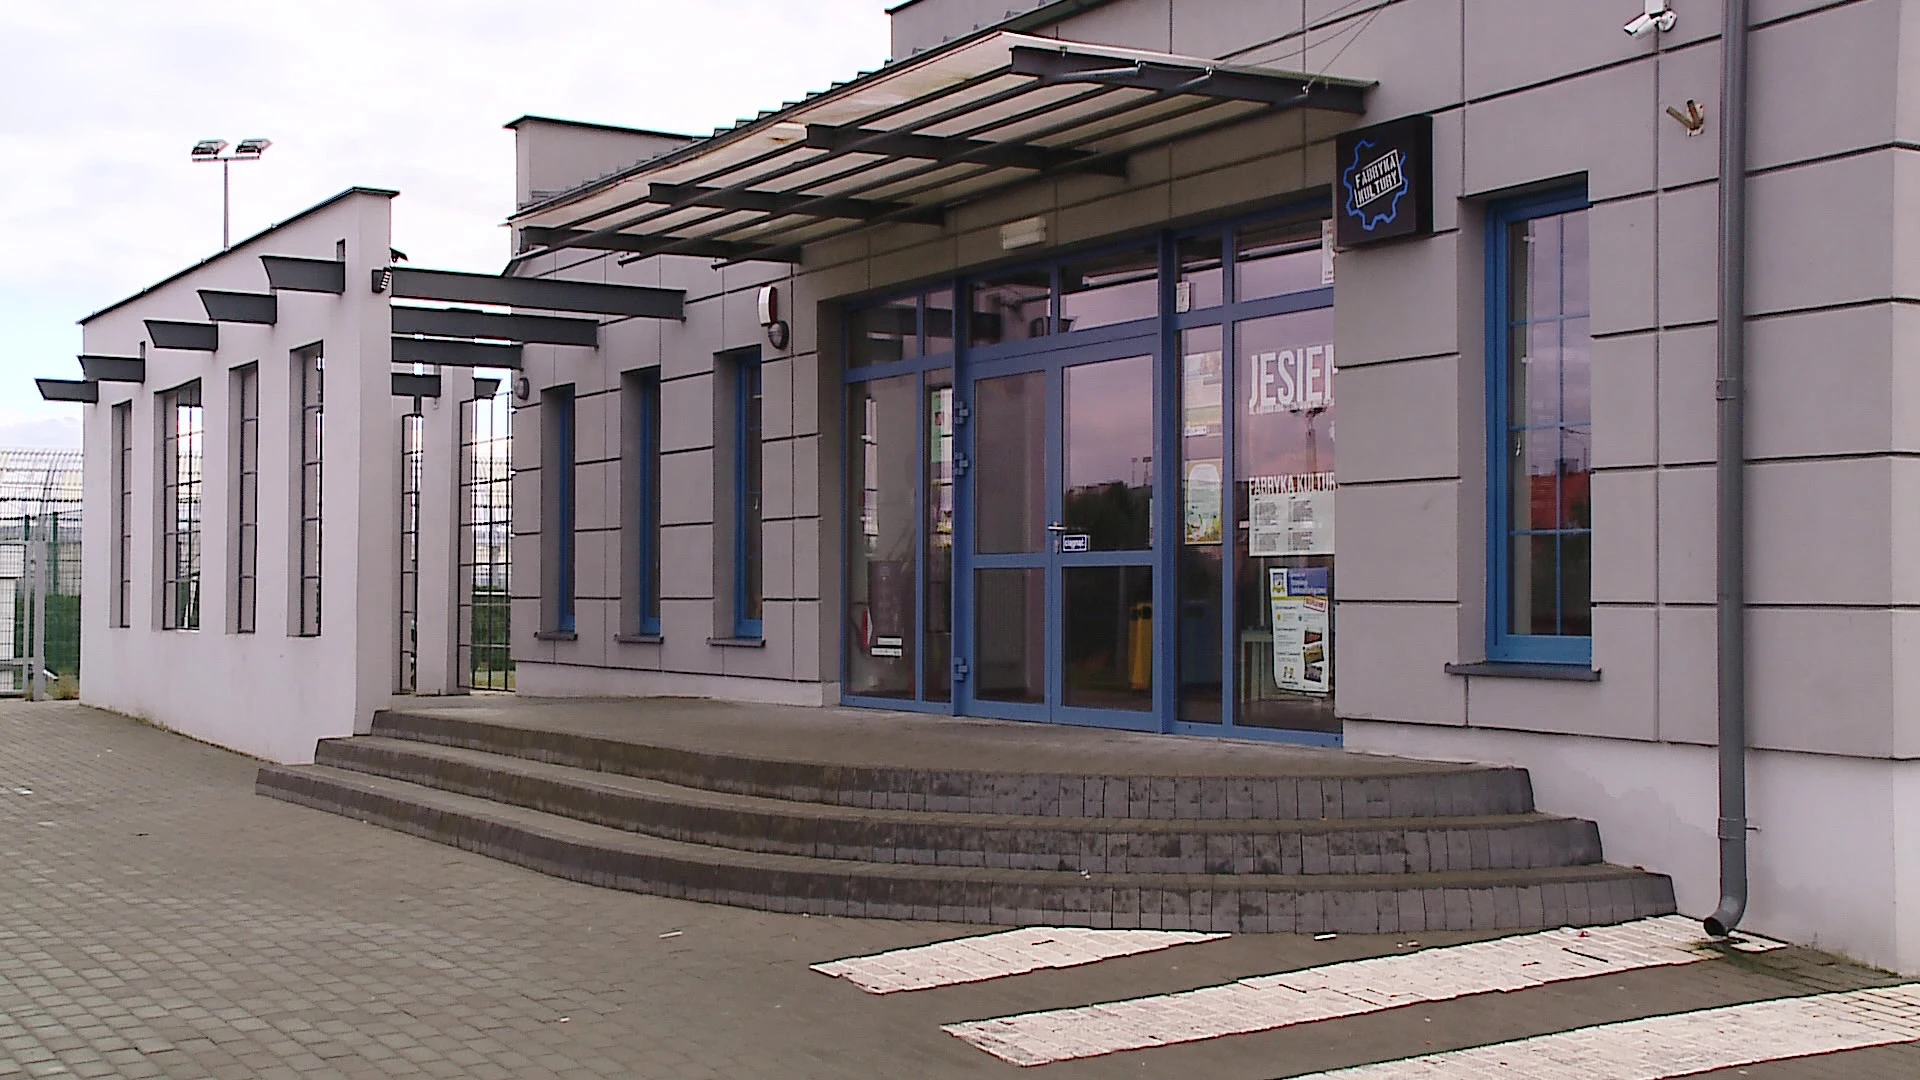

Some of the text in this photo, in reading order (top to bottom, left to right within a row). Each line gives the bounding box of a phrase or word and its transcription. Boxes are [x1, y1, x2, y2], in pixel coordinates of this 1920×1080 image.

[1355, 155, 1396, 189] FABRYKA
[1357, 170, 1397, 204] KULTURY
[1249, 474, 1294, 496] FABRYKA
